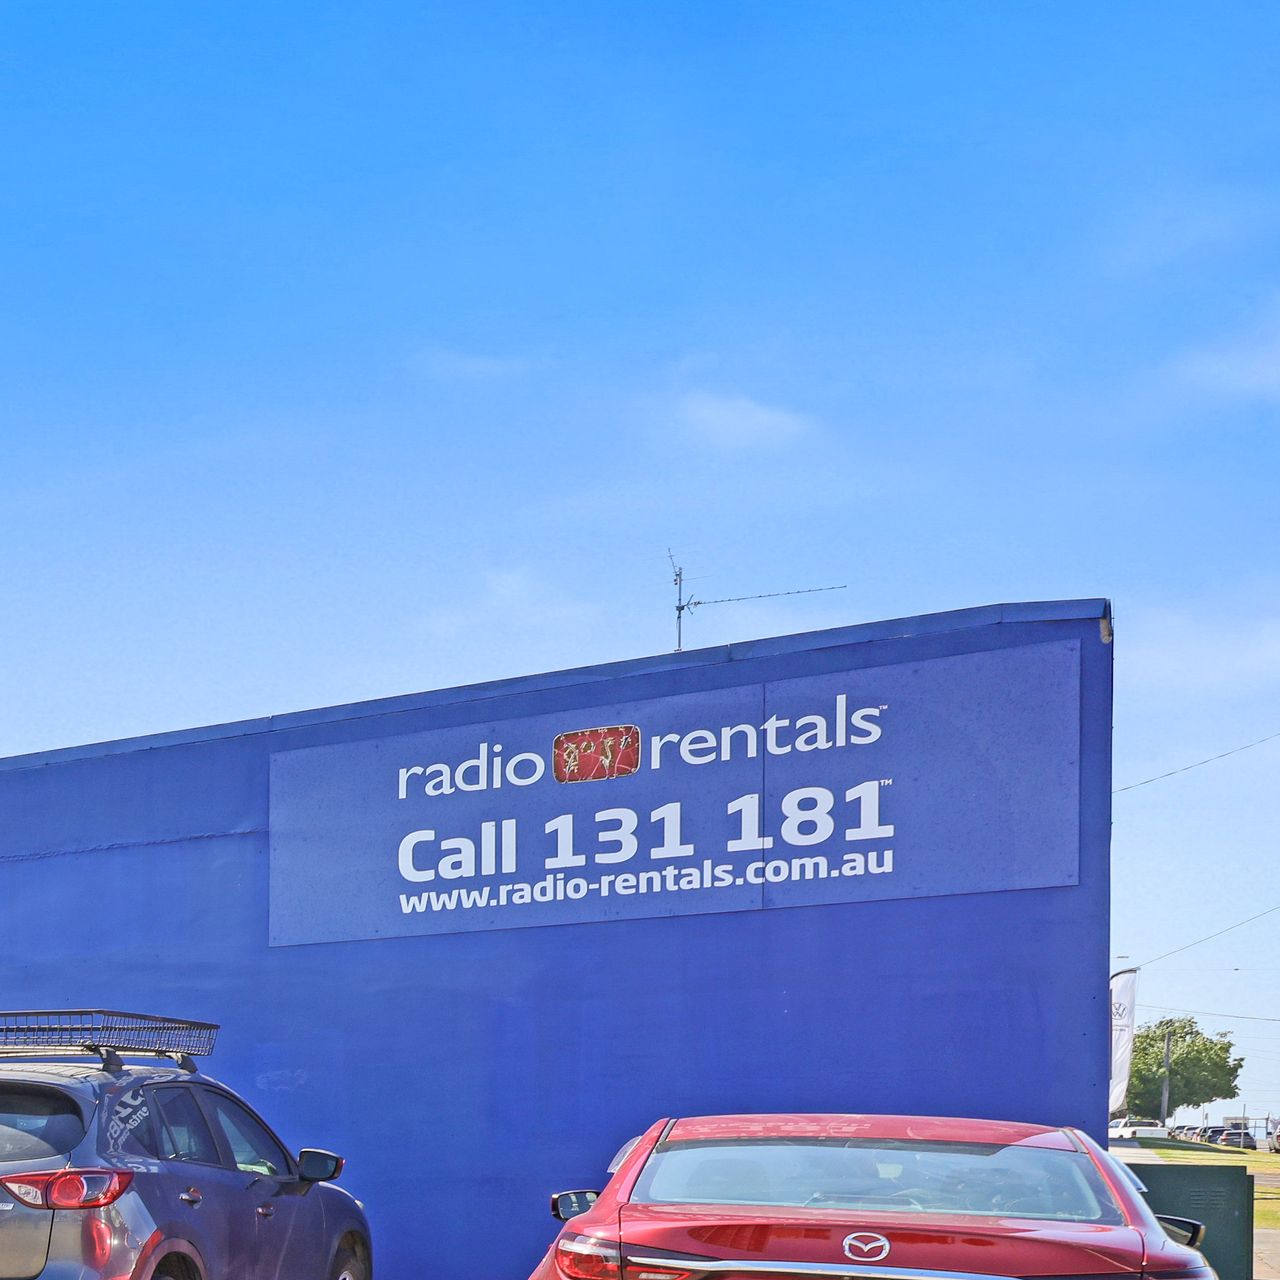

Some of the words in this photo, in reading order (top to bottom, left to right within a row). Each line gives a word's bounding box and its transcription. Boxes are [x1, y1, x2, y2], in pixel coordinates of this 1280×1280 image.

[397, 742, 545, 800] radio
[397, 818, 517, 883] Call
[543, 801, 695, 870] 131
[398, 849, 894, 914] www.radio-rentals.com.au
